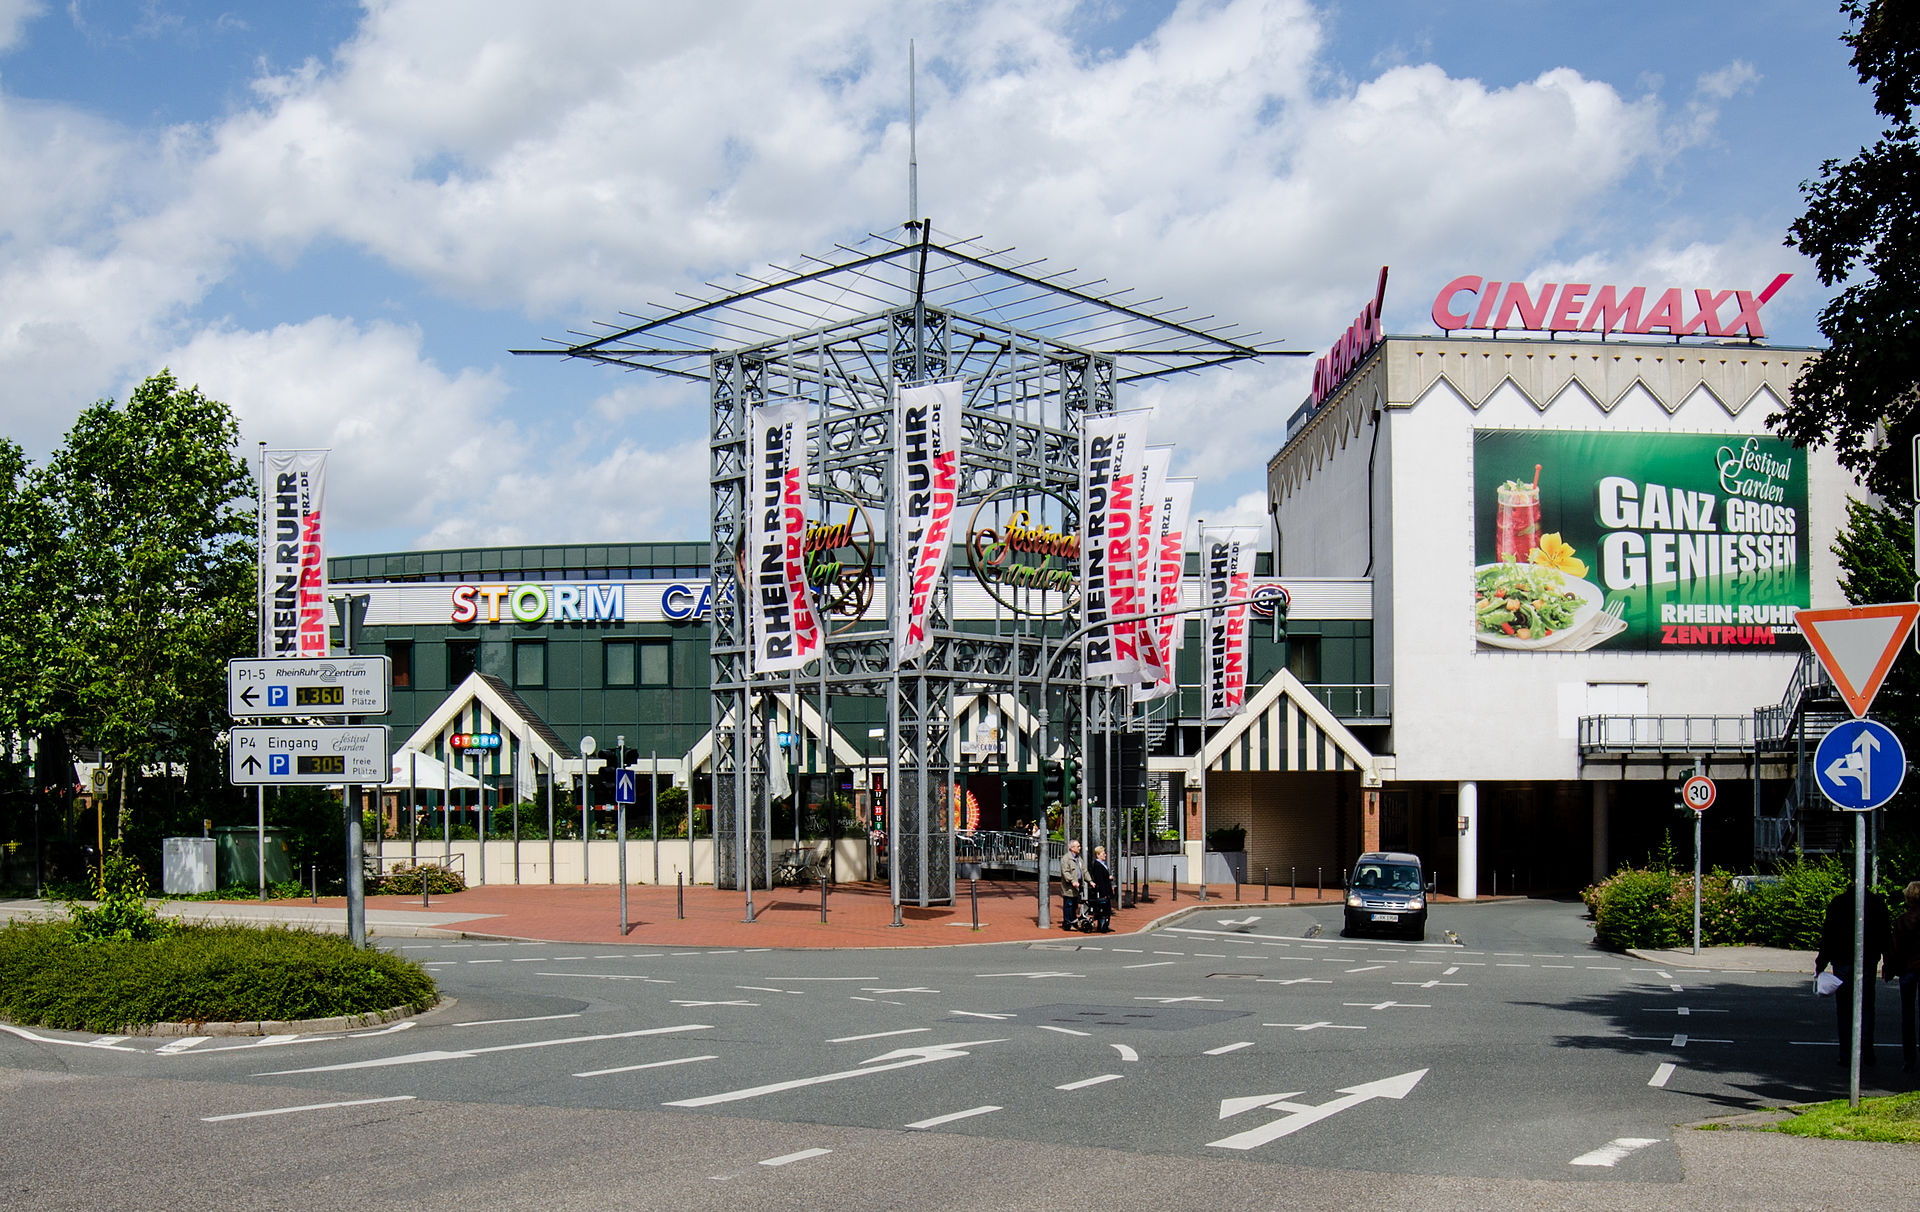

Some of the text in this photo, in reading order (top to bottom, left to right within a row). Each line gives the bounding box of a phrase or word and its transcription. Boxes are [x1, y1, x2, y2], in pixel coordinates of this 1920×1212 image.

[1432, 273, 1794, 337] CINEMAXX
[933, 403, 941, 459] RRZ.DE
[1112, 433, 1126, 482] RRZ.DE
[1716, 437, 1792, 481] festival
[300, 471, 310, 517] RRZ.DE
[1720, 459, 1784, 503] Garden
[1161, 496, 1173, 538] RRZ.DE
[1597, 476, 1796, 535] GANZ GROSS
[760, 424, 793, 659] RHEIN-RUHR
[783, 467, 818, 656] ZENTRUM
[909, 450, 956, 645] ZENTRUM
[1230, 540, 1240, 577] RRZ.DE
[1602, 531, 1797, 591] GENIESSEN
[273, 471, 300, 657] HEIN-RUHR
[300, 510, 326, 657] ENTRUM
[982, 542, 1074, 593] Garden
[451, 583, 625, 623] STORM
[1661, 625, 1776, 645] ZENTRUM
[238, 669, 266, 681] P1-5
[276, 668, 318, 677] RheinRuhr
[299, 688, 343, 704] 1360
[351, 688, 371, 696] freie
[272, 688, 284, 705] P
[240, 737, 318, 751] P4 Eingang
[352, 758, 371, 766] freie
[454, 736, 499, 746] STORM
[273, 756, 285, 773] P
[311, 757, 343, 773] 305
[1690, 785, 1709, 801] 30
